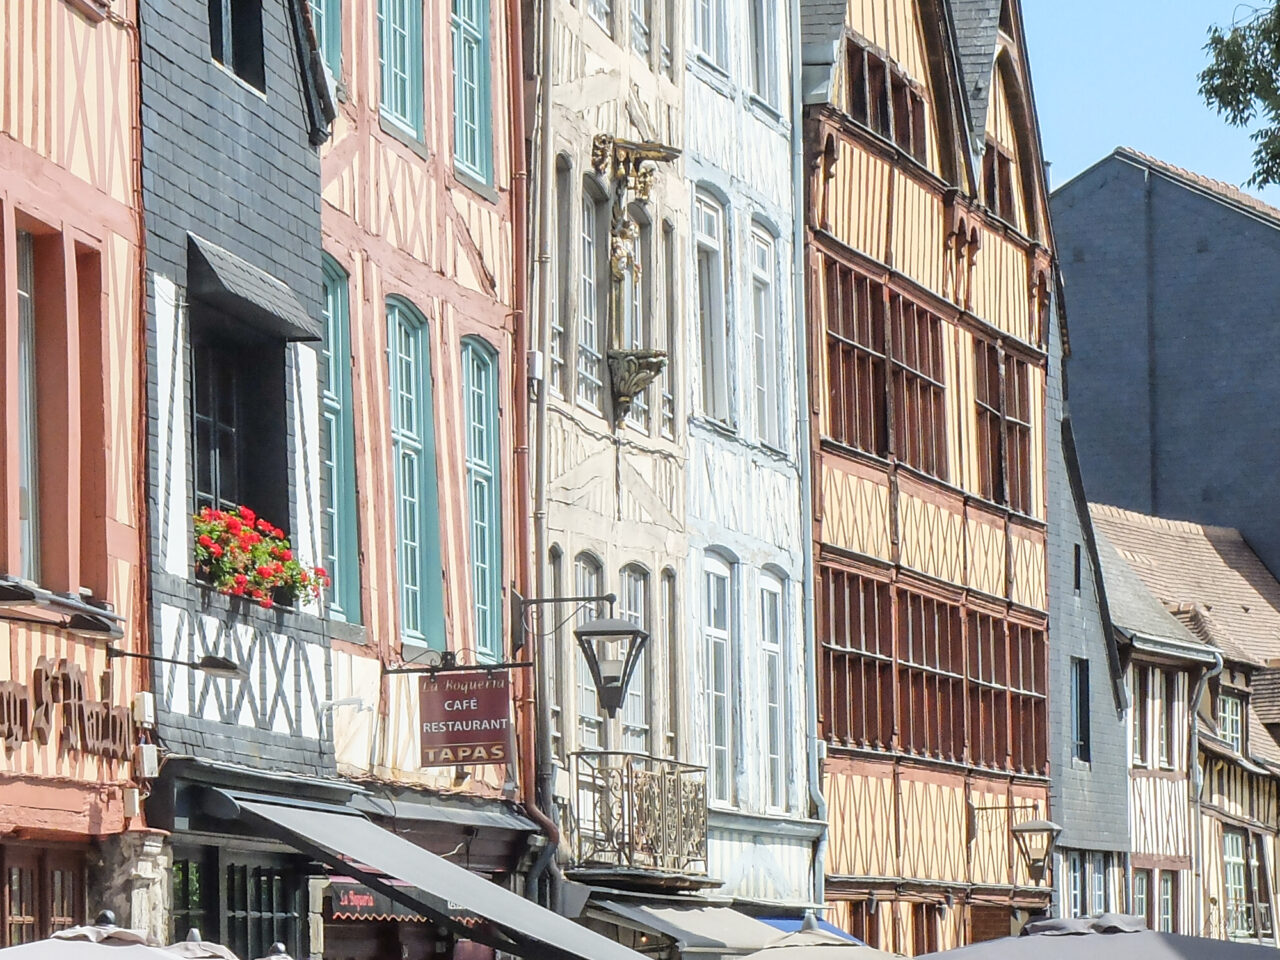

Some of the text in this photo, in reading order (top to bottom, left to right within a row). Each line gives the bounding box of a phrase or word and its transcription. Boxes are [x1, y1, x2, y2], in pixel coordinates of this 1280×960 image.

[444, 697, 478, 711] CAFÉ
[423, 718, 508, 733] RESTAURANT
[424, 745, 505, 762] TAPAS
